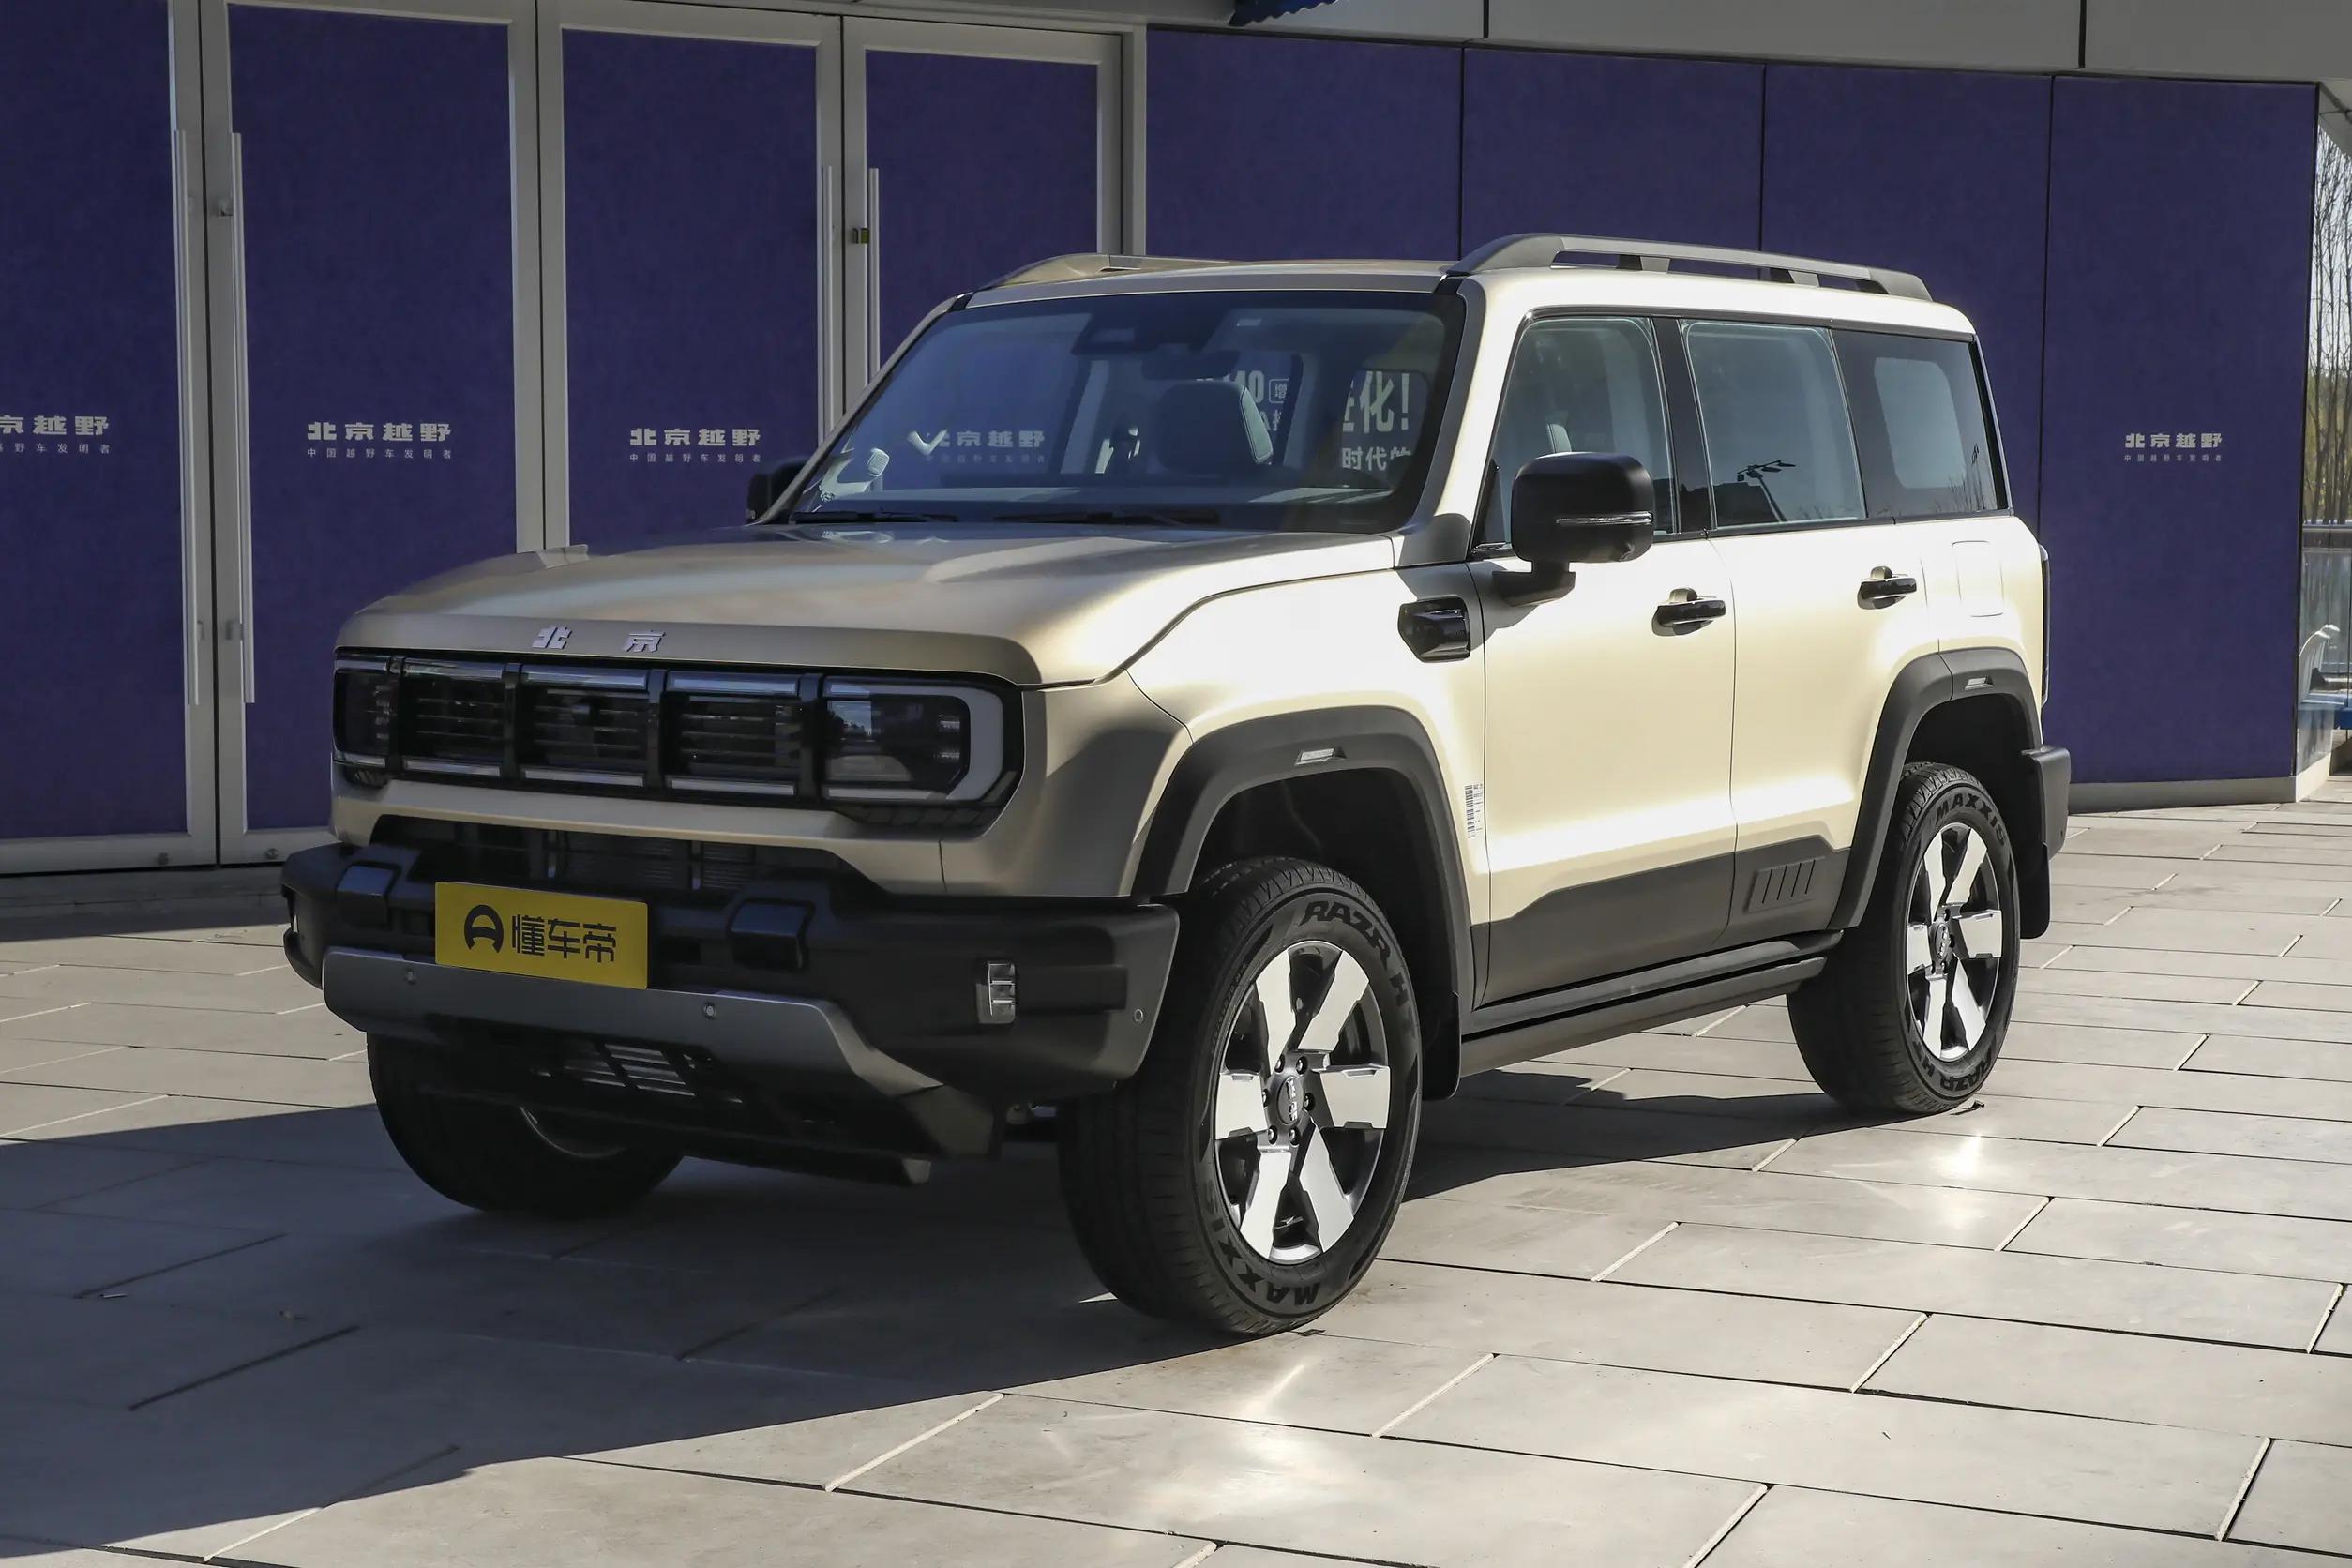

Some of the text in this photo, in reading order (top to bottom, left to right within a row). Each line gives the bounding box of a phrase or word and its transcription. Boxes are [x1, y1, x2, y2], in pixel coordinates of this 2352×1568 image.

[0, 415, 109, 435] 京越野
[307, 422, 451, 442] 北京越野
[630, 428, 761, 446] 北京越野
[2125, 433, 2223, 448] 北京越野
[307, 448, 451, 459] 中国越野车发明者
[629, 453, 761, 462] 中国越野车发明者
[532, 626, 667, 654] 北京
[1936, 792, 2005, 846] MAXXIS
[511, 913, 617, 963] 懂车帝
[1298, 900, 1392, 971] RAZR
[1204, 1178, 1321, 1306] MAXXIS
